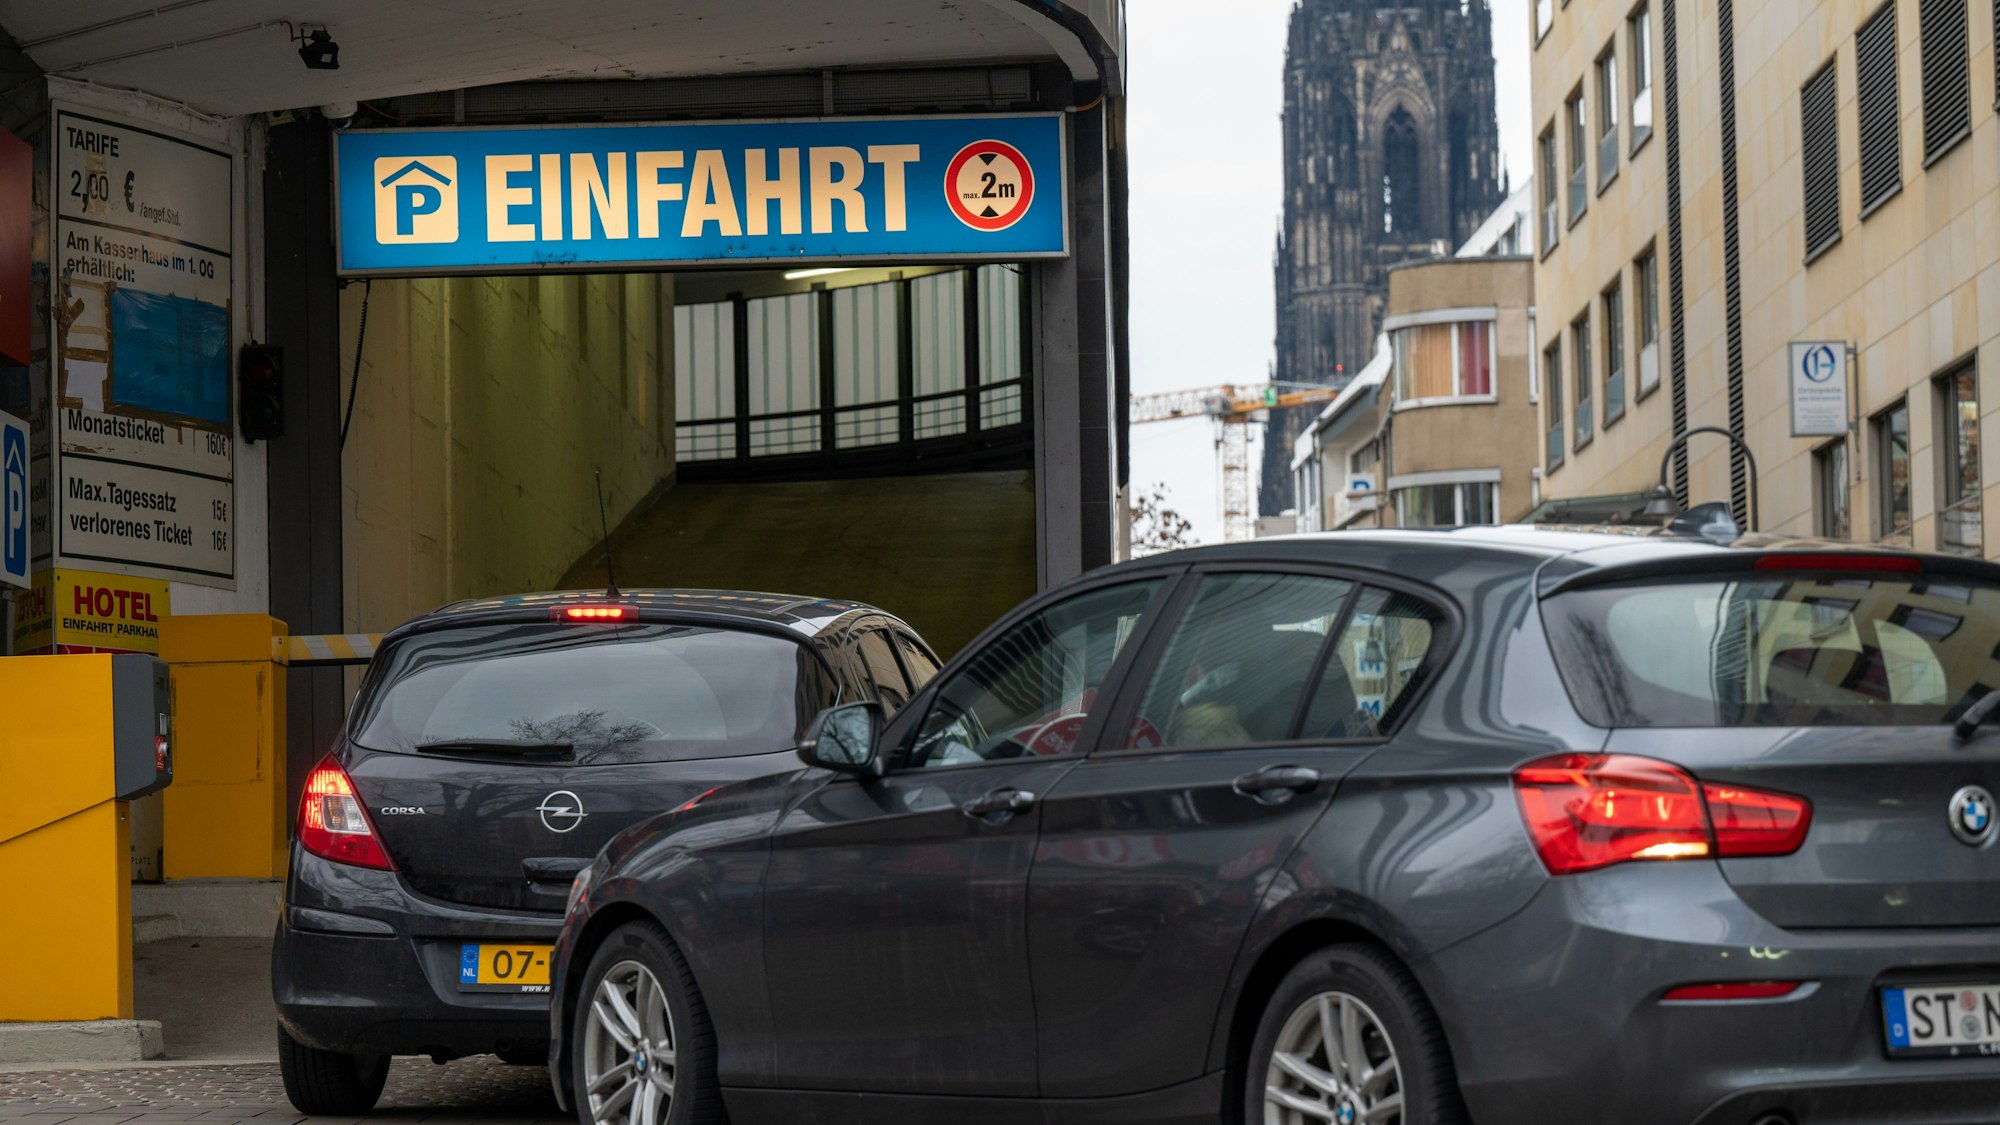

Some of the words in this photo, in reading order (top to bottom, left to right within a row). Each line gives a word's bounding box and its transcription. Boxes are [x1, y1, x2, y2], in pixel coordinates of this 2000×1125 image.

[66, 126, 120, 157] TARIFE
[124, 169, 135, 213] €
[395, 184, 442, 236] P
[485, 143, 920, 243] EINFAHRT
[963, 192, 980, 200] max.
[66, 231, 90, 252] Am
[94, 235, 169, 268] Kassenhaus
[172, 256, 185, 271] im
[188, 258, 196, 274] 1.
[199, 258, 215, 279] OG
[66, 255, 135, 283] erhältlich:
[67, 408, 165, 445] Monatsticket
[205, 432, 226, 457] 160€
[9, 471, 24, 559] P
[211, 499, 227, 523] 15€
[70, 511, 151, 540] verlorenes
[154, 519, 193, 546] Ticket
[211, 529, 227, 552] 16€
[73, 585, 158, 622] HOTEL
[63, 617, 114, 634] EINFAHRT
[381, 805, 426, 816] CORSA
[462, 967, 476, 978] NL
[493, 949, 553, 979] 07-
[1893, 1023, 1905, 1038] D
[1911, 993, 1956, 1040] ST
